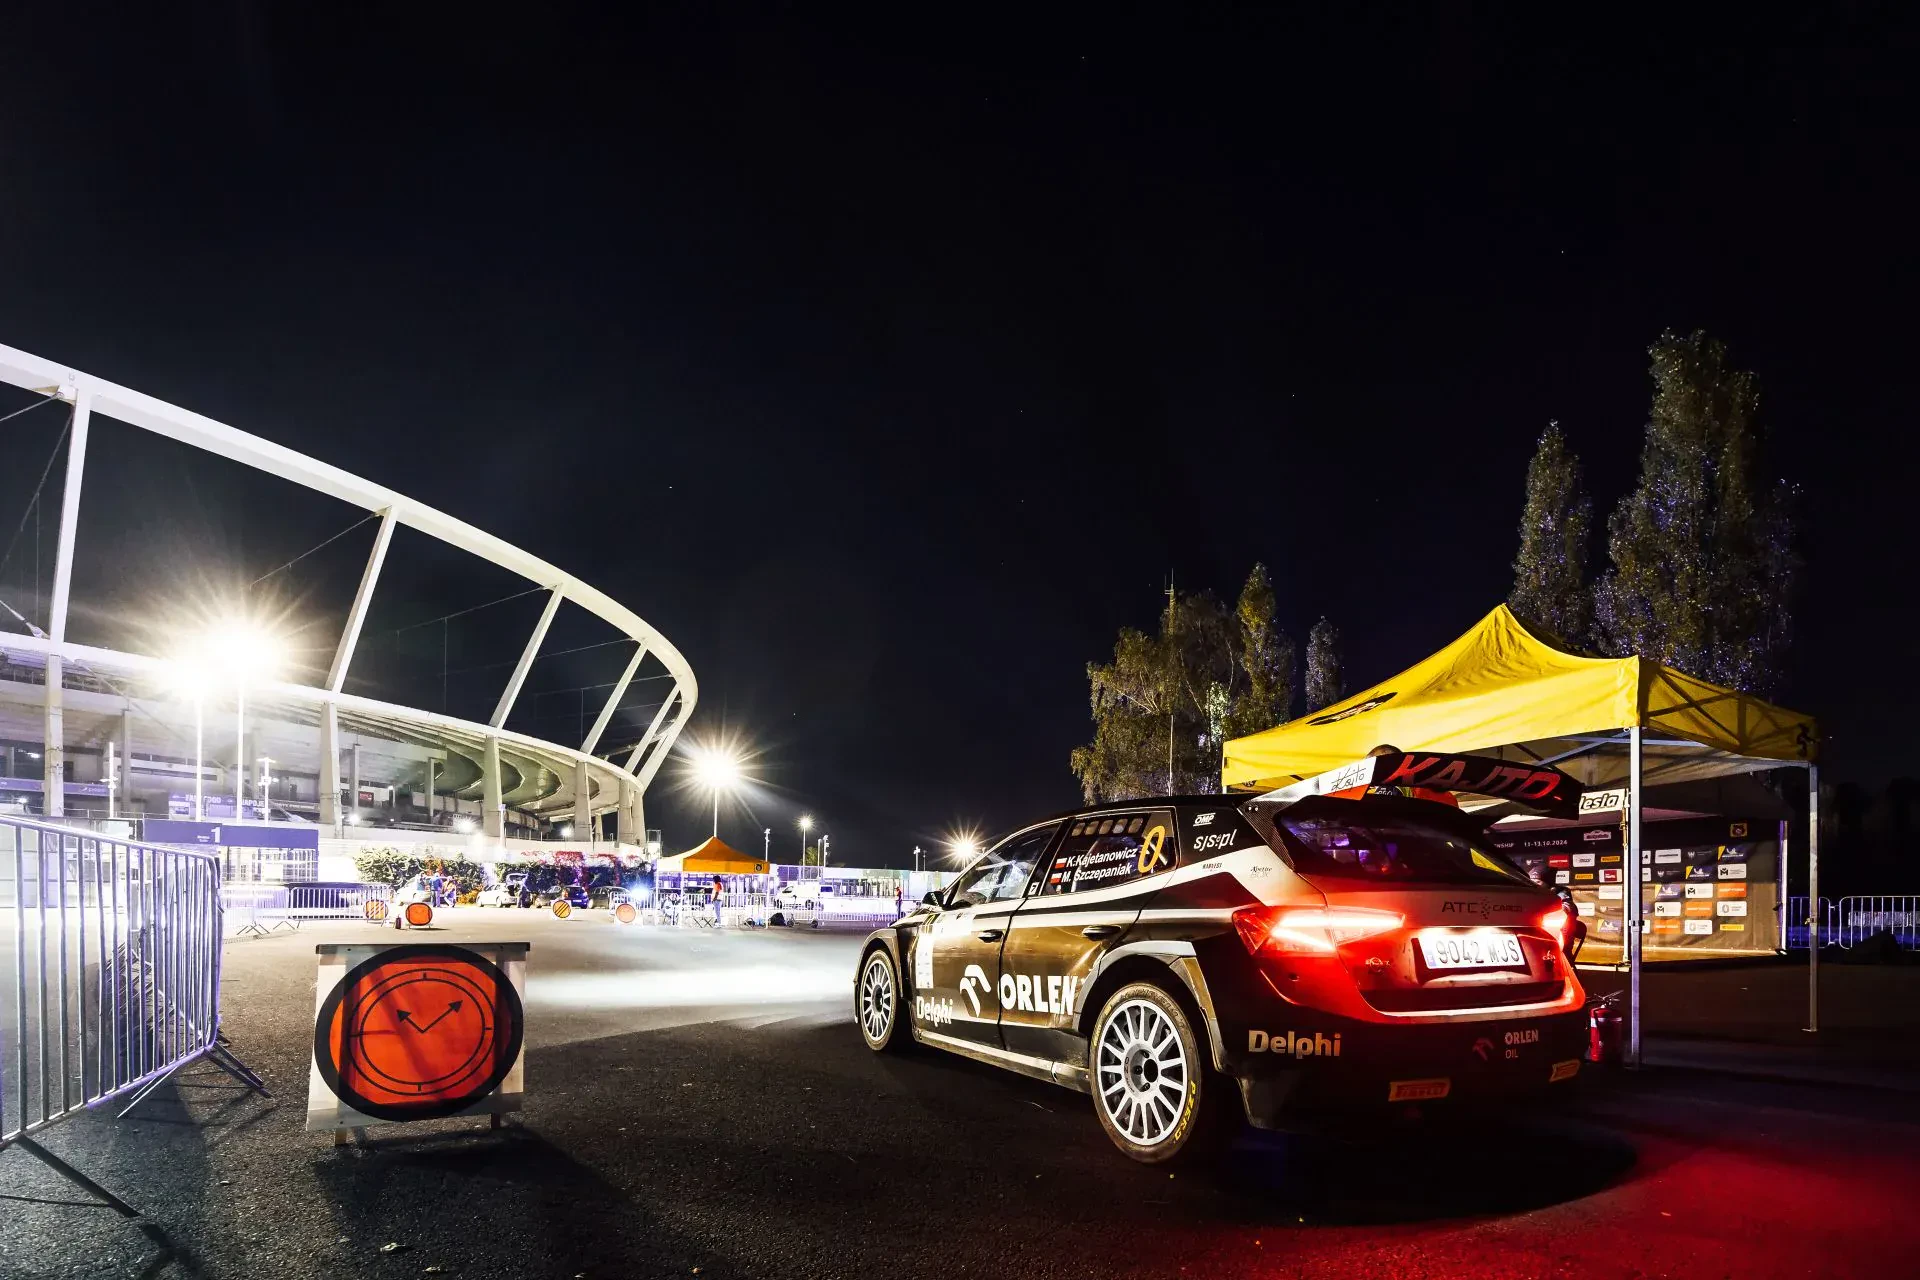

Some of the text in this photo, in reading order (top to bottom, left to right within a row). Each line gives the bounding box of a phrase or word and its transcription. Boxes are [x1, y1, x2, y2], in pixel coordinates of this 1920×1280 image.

[1384, 754, 1561, 799] KAJTO
[1194, 813, 1215, 825] OMP
[211, 827, 221, 843] 1
[1061, 863, 1133, 882] M. Szczepaniak
[1441, 901, 1478, 913] ATC
[1436, 940, 1484, 964] 9042
[1488, 940, 1519, 962] MJS
[998, 973, 1078, 1015] ORLEN
[916, 996, 953, 1028] Delphi
[1248, 1029, 1341, 1059] Delphi
[1504, 1029, 1539, 1045] ORLEN
[1505, 1049, 1519, 1059] OIL
